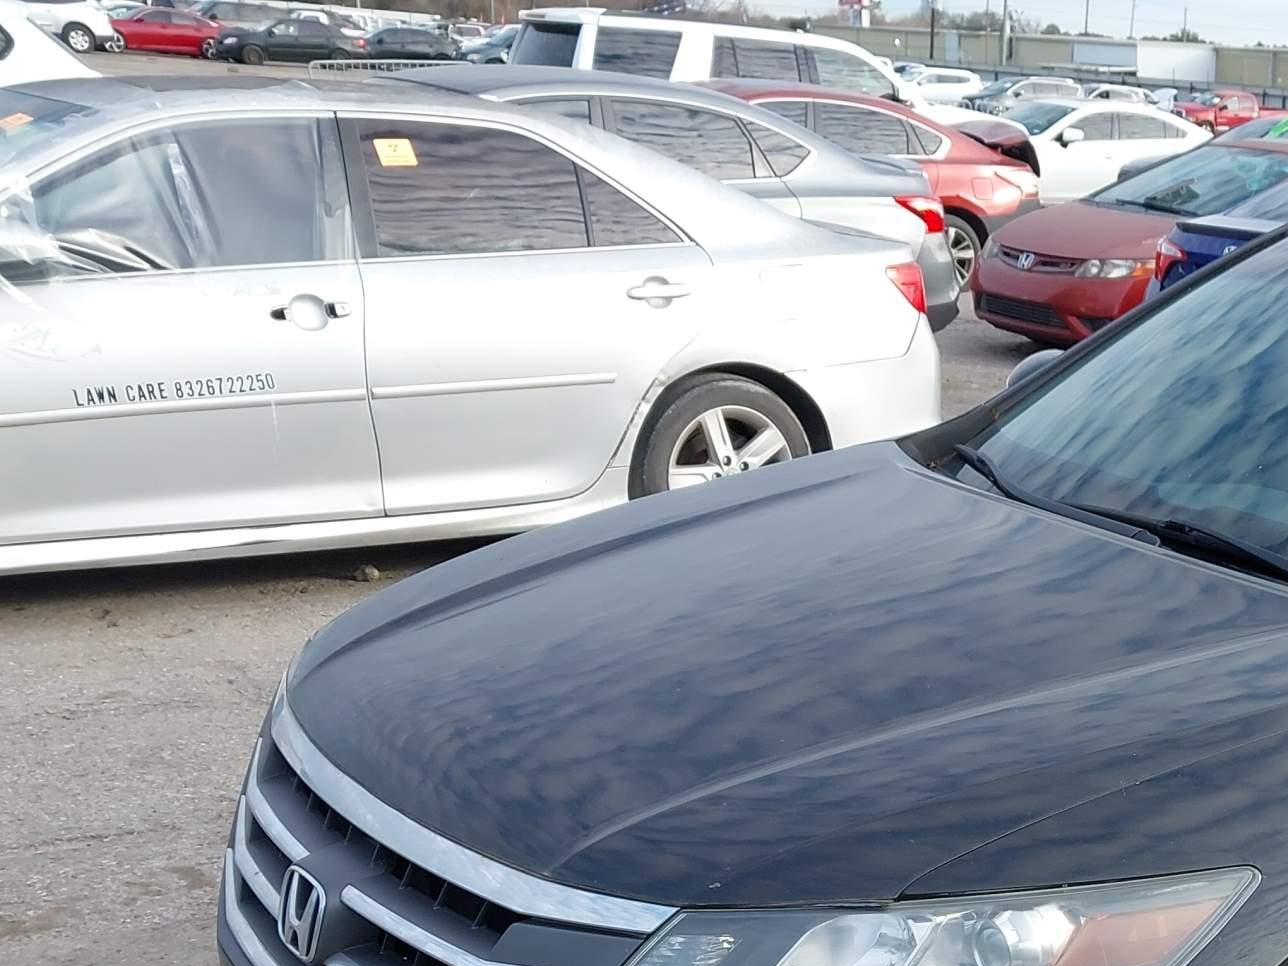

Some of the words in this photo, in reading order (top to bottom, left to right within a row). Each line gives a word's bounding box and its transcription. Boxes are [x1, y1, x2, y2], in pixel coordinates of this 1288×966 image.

[73, 386, 118, 407] LAWN
[125, 382, 168, 402] CARE
[174, 373, 275, 398] 8326722250
